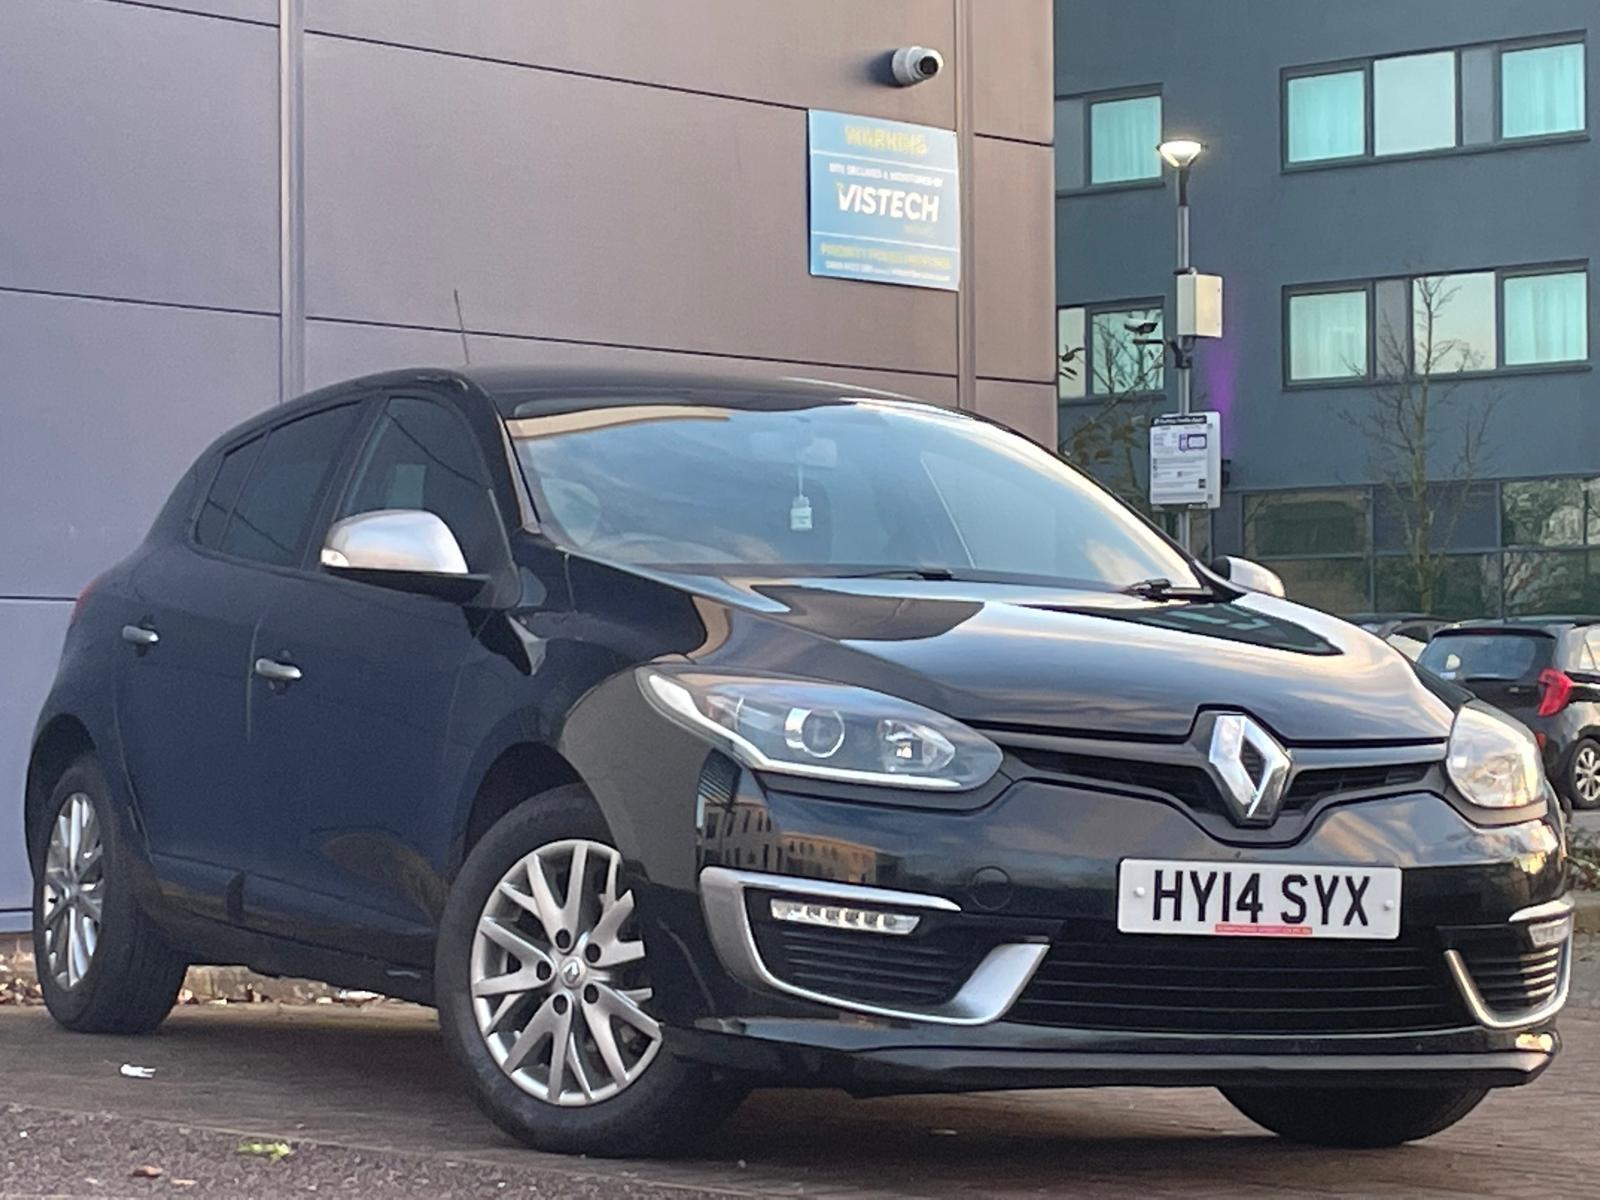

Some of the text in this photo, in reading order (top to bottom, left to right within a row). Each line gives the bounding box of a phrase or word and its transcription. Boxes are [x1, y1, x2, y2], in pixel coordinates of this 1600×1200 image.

[838, 184, 940, 222] VISTECH
[1152, 870, 1371, 926] HY14 SYX
